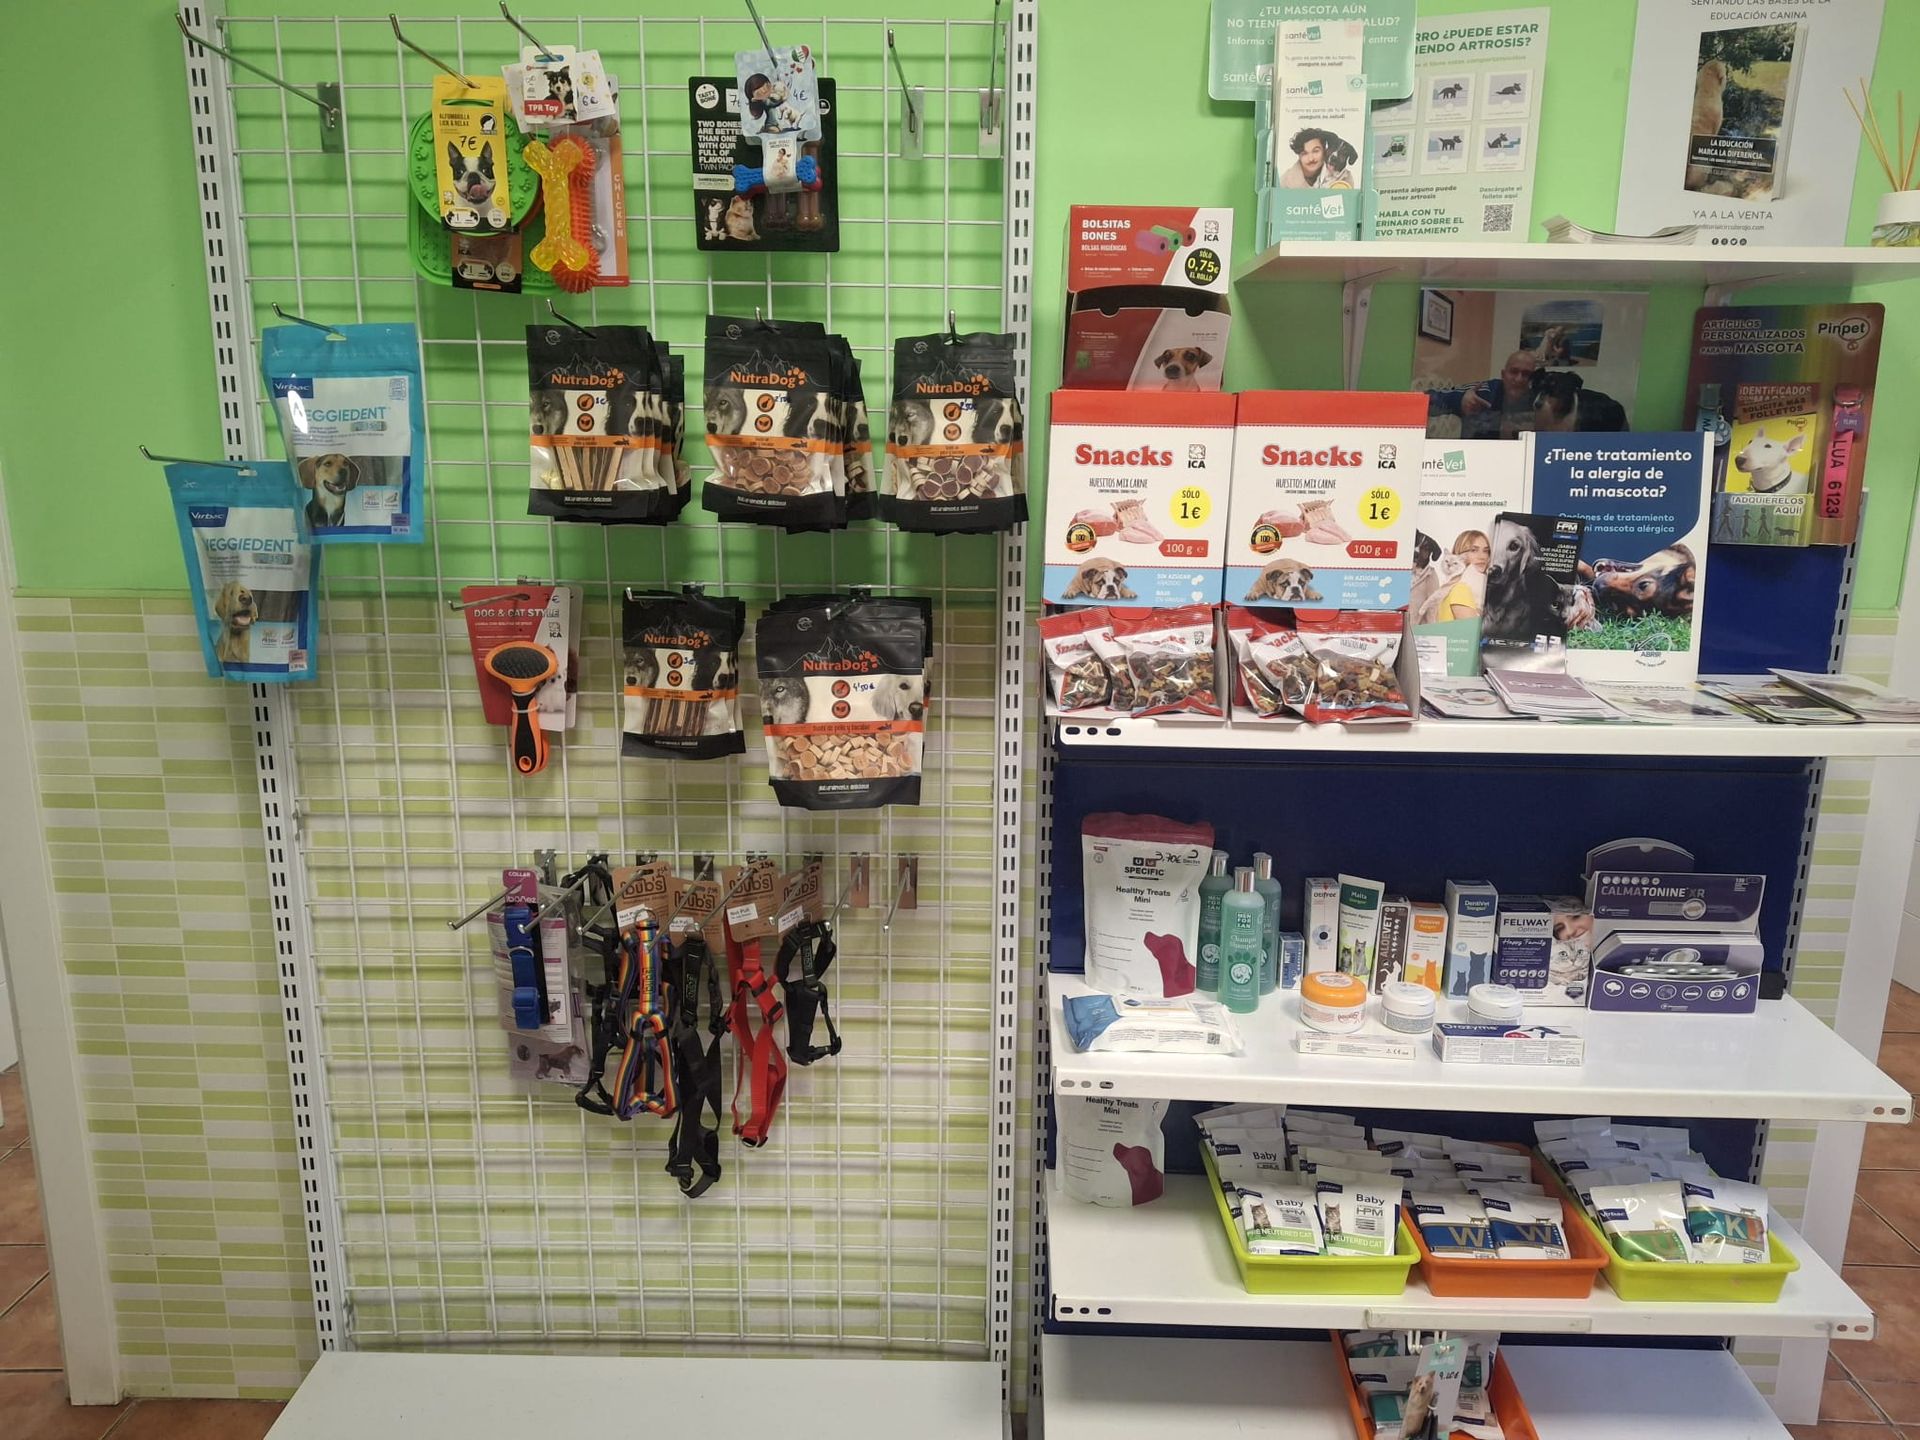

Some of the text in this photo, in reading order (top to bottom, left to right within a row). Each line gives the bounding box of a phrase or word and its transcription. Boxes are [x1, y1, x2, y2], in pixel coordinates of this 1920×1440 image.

[1259, 2, 1366, 17] ¿TU MASCOTA AÚN
[1710, 11, 1808, 20] EDUCACIÓN CANINA
[1227, 19, 1244, 28] NO
[1443, 23, 1539, 40] ¿PUEDE ESTAR
[1228, 36, 1264, 45] Informa
[1459, 36, 1532, 51] ARTROSIS?
[698, 90, 715, 99] TASTY
[528, 103, 559, 113] TPR Toy
[697, 127, 714, 135] ARE
[459, 135, 477, 151] 7€
[1719, 140, 1754, 149] EDUCACIÓN
[1698, 148, 1718, 156] MARCA
[613, 174, 625, 238] CHICKEN
[1286, 200, 1343, 215] santéVet
[1411, 209, 1431, 217] CON
[1693, 210, 1773, 220] YA A LA VENTA
[1082, 219, 1132, 229] BOLSITAS
[1420, 217, 1450, 225] SOBRE
[1082, 231, 1117, 241] BONES
[1396, 226, 1459, 235] TRATAMIENTO
[1203, 233, 1220, 242] ICA
[1199, 249, 1213, 258] SÓLO
[1196, 273, 1213, 282] ROLLO
[1703, 319, 1866, 337] ARTÍCULOS Pinpet
[1702, 330, 1806, 341] PERSONALIZADOS
[1735, 342, 1804, 354] MASCOTA
[551, 372, 615, 390] NutraDog
[730, 371, 796, 390] NutraDog
[916, 382, 980, 396] NutraDog
[1750, 406, 1804, 419] FOLLETOS
[1075, 444, 1206, 469] Snacks ICA
[1262, 444, 1396, 470] Snacks ICA
[1544, 449, 1692, 464] ¿Tiene tratamiento
[1831, 440, 1847, 470] LUA
[1570, 467, 1664, 482] la alergia de
[1089, 478, 1148, 489] HUESITOS MIX CARNE
[1275, 478, 1337, 490] HUESITOS MIX CARNE
[1182, 489, 1200, 500] SÓLO
[1371, 490, 1390, 500] SÓLO
[1570, 485, 1667, 499] mi mascota?
[190, 511, 225, 521] Virbac
[1603, 513, 1675, 522] de tratamiento
[1594, 524, 1675, 535] mascota alérgica
[1166, 543, 1184, 553] 100
[1354, 545, 1371, 554] 100
[474, 608, 495, 618] DOG
[507, 608, 525, 618] CAT
[527, 608, 560, 619] STYLE
[549, 631, 562, 639] ICA
[643, 634, 700, 649] NutraDog
[803, 659, 869, 674] NutraDog
[1124, 866, 1165, 877] SPECIFIC
[1116, 885, 1171, 898] Healthy Treats
[1600, 886, 1706, 899] CALMATONINE XR
[1134, 896, 1151, 905] Mini
[1503, 918, 1549, 927] FELIWAY
[1380, 916, 1393, 957] ALOEVET
[1502, 939, 1547, 947] Happy Family
[1086, 1096, 1139, 1109] Healthy Treats
[1104, 1106, 1120, 1115] Mini
[1253, 1152, 1277, 1162] Baby
[1275, 1200, 1304, 1208] Baby
[1356, 1194, 1385, 1206] Baby
[1448, 1226, 1485, 1248] W
[1515, 1224, 1552, 1245] W
